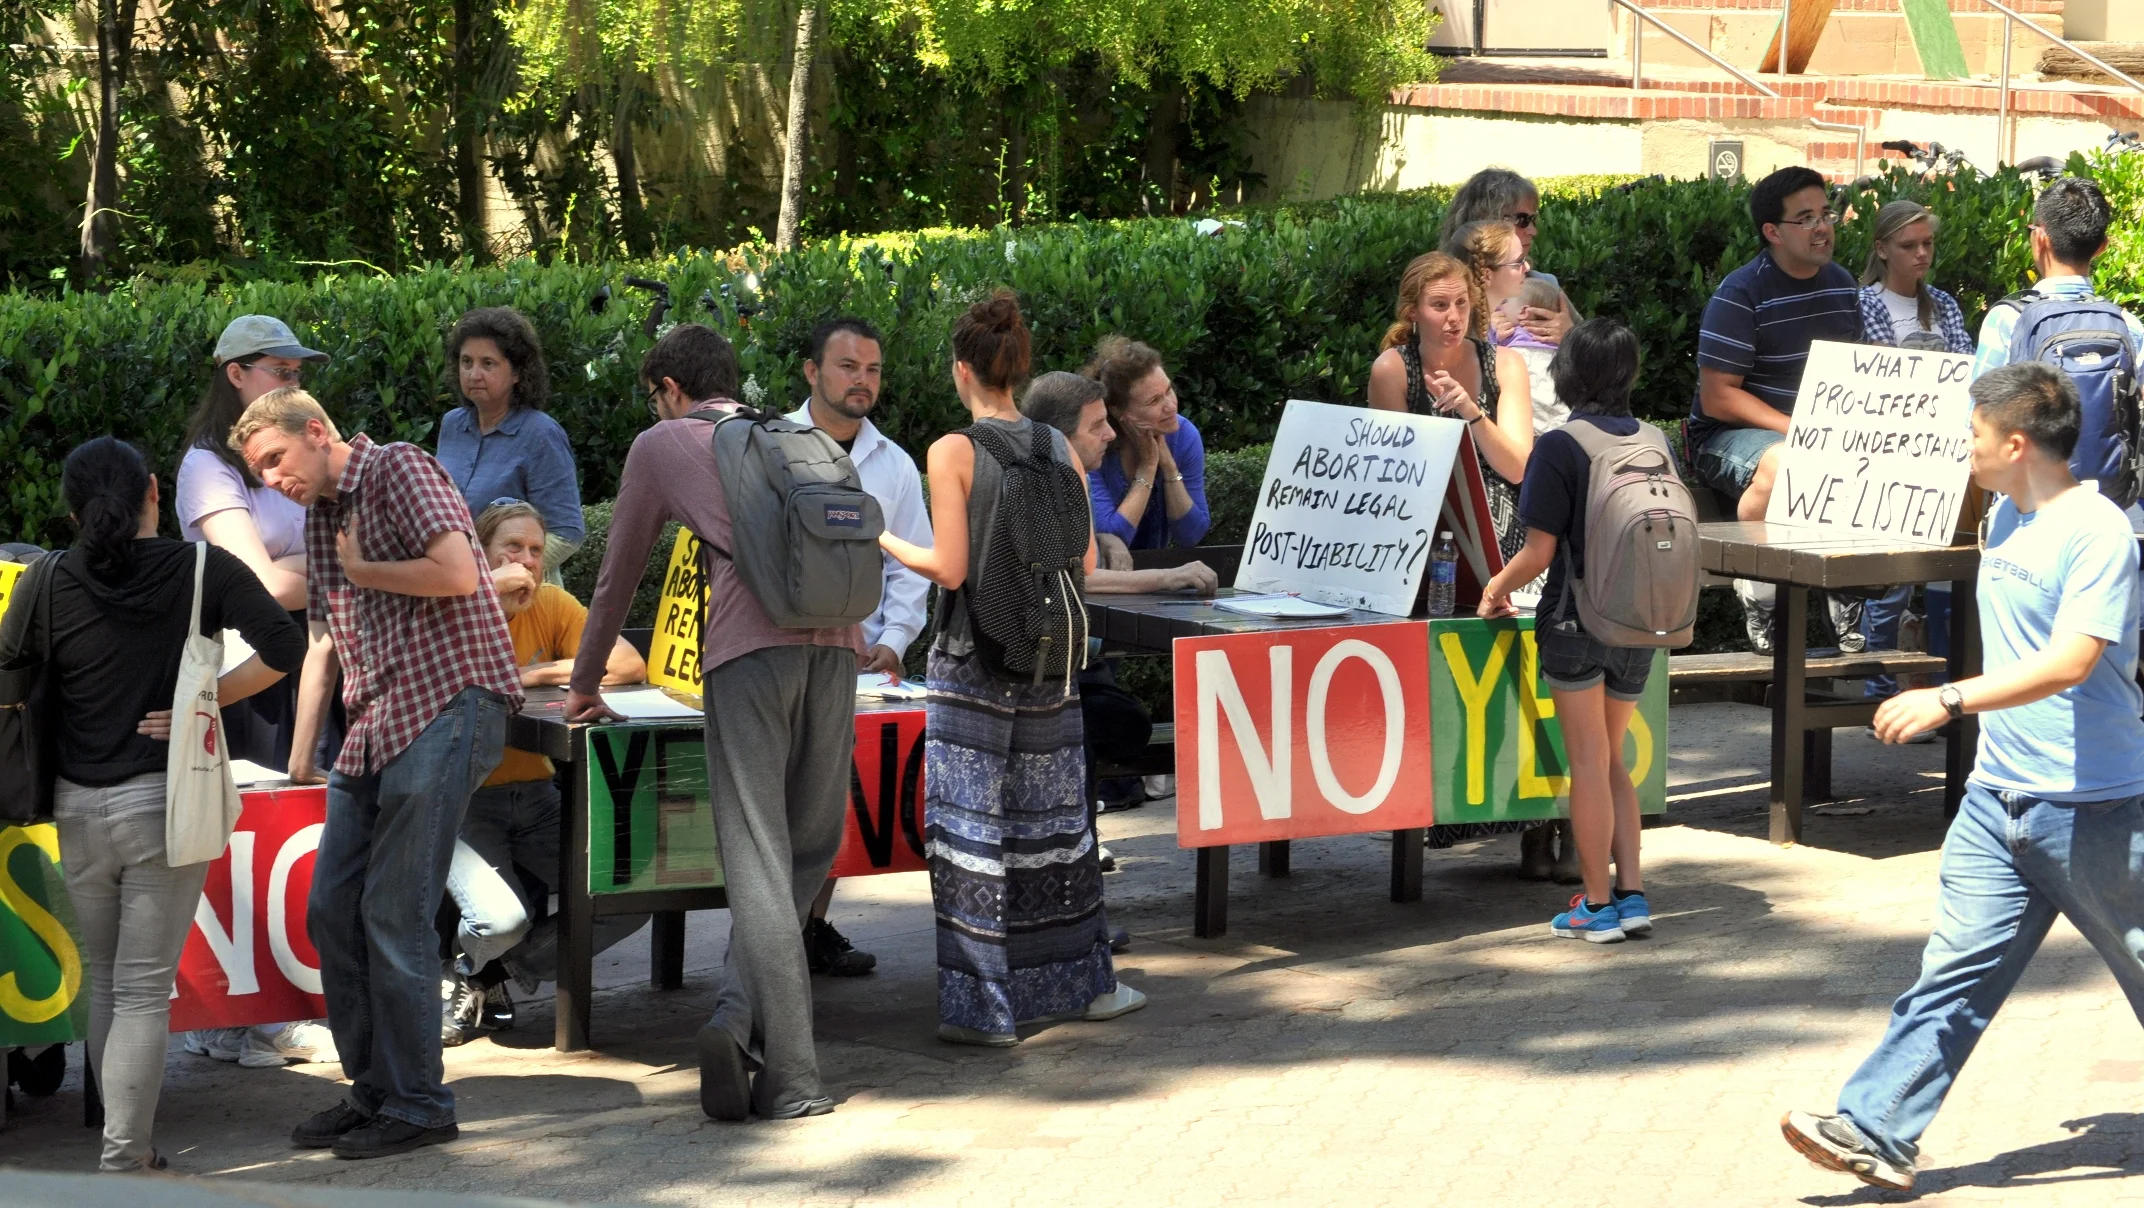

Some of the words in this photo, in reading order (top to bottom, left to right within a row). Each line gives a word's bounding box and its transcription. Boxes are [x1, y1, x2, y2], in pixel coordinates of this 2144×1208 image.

[1853, 349, 1923, 379] WHAT
[1937, 358, 1969, 383] DO
[1811, 381, 1939, 418] PRO-LIFERS
[1345, 417, 1415, 448] SHOULD
[1791, 424, 1833, 450] NOT
[1292, 444, 1427, 487] ABORTION
[1856, 456, 1870, 484] ?
[1266, 477, 1339, 510] REMAIN
[1343, 492, 1413, 521] LEGAL
[1786, 468, 1844, 524] WE
[1247, 521, 1428, 585] POST-VIABILITY?
[1196, 639, 1405, 830] NO
